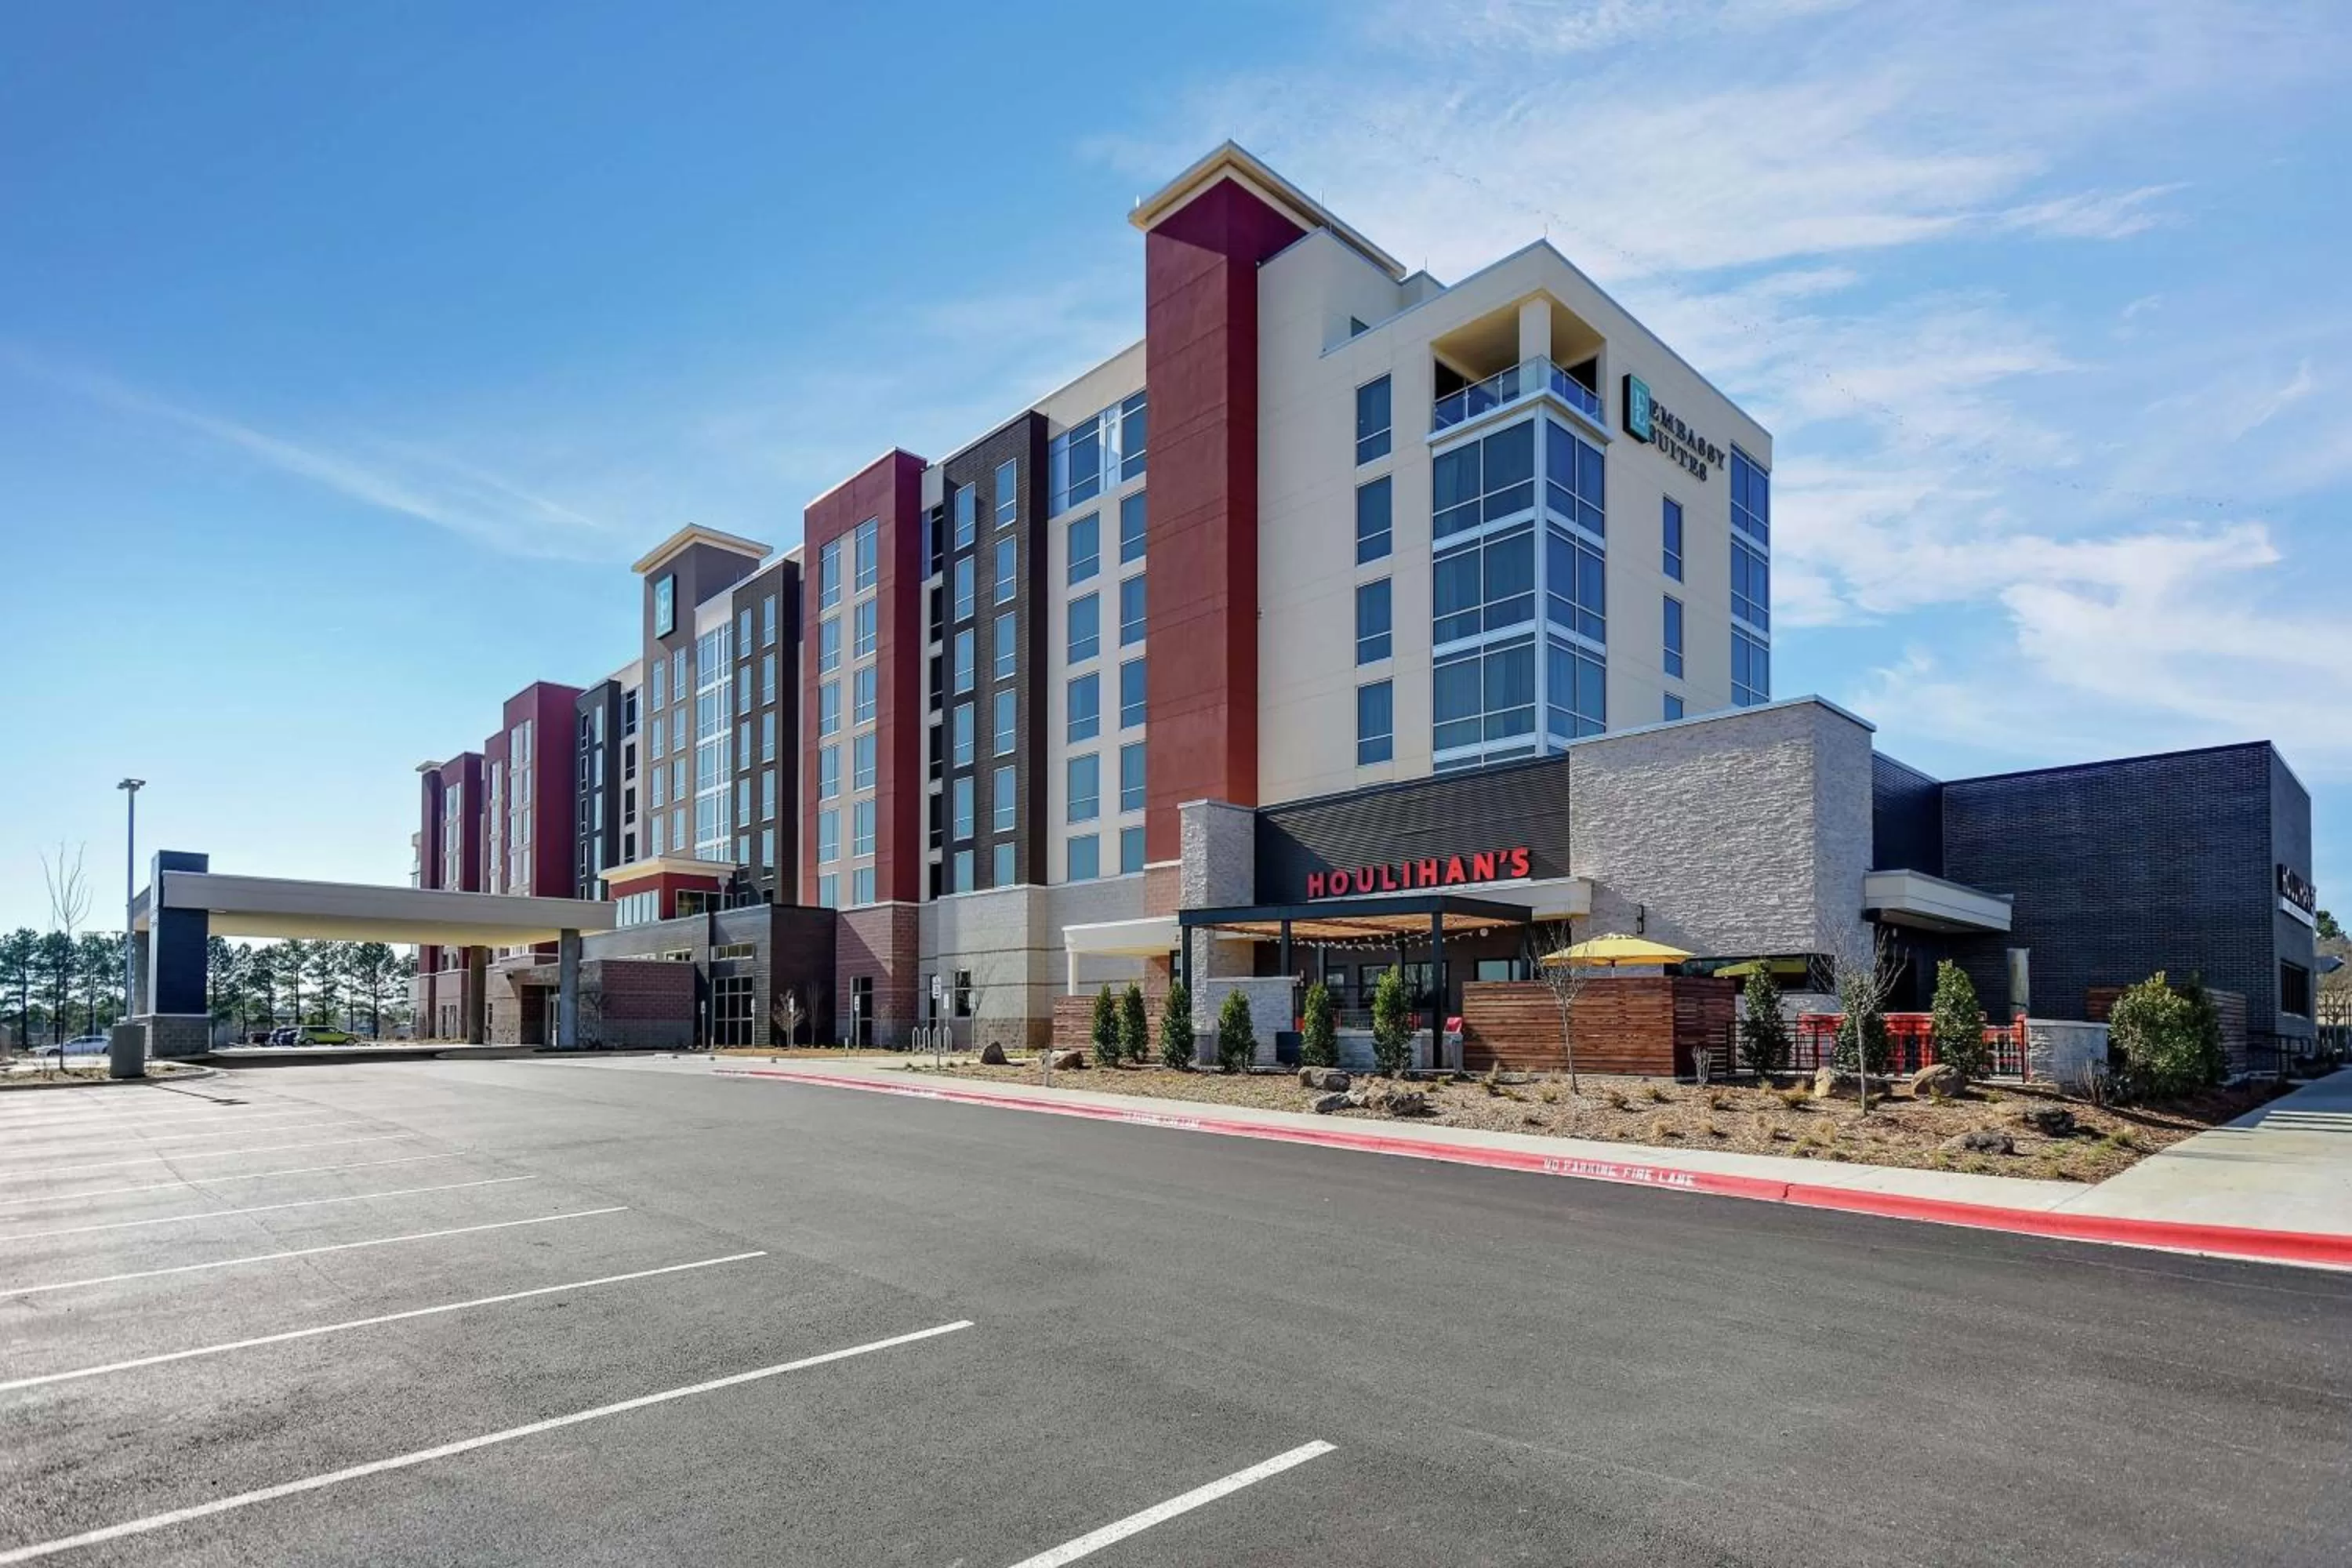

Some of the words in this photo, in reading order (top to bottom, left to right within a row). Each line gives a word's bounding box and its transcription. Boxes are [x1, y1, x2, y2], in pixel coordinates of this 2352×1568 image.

[1650, 397, 1725, 470] EMBASSY
[1650, 424, 1707, 481] SUITES
[1307, 846, 1530, 898] HOULIHAN'S
